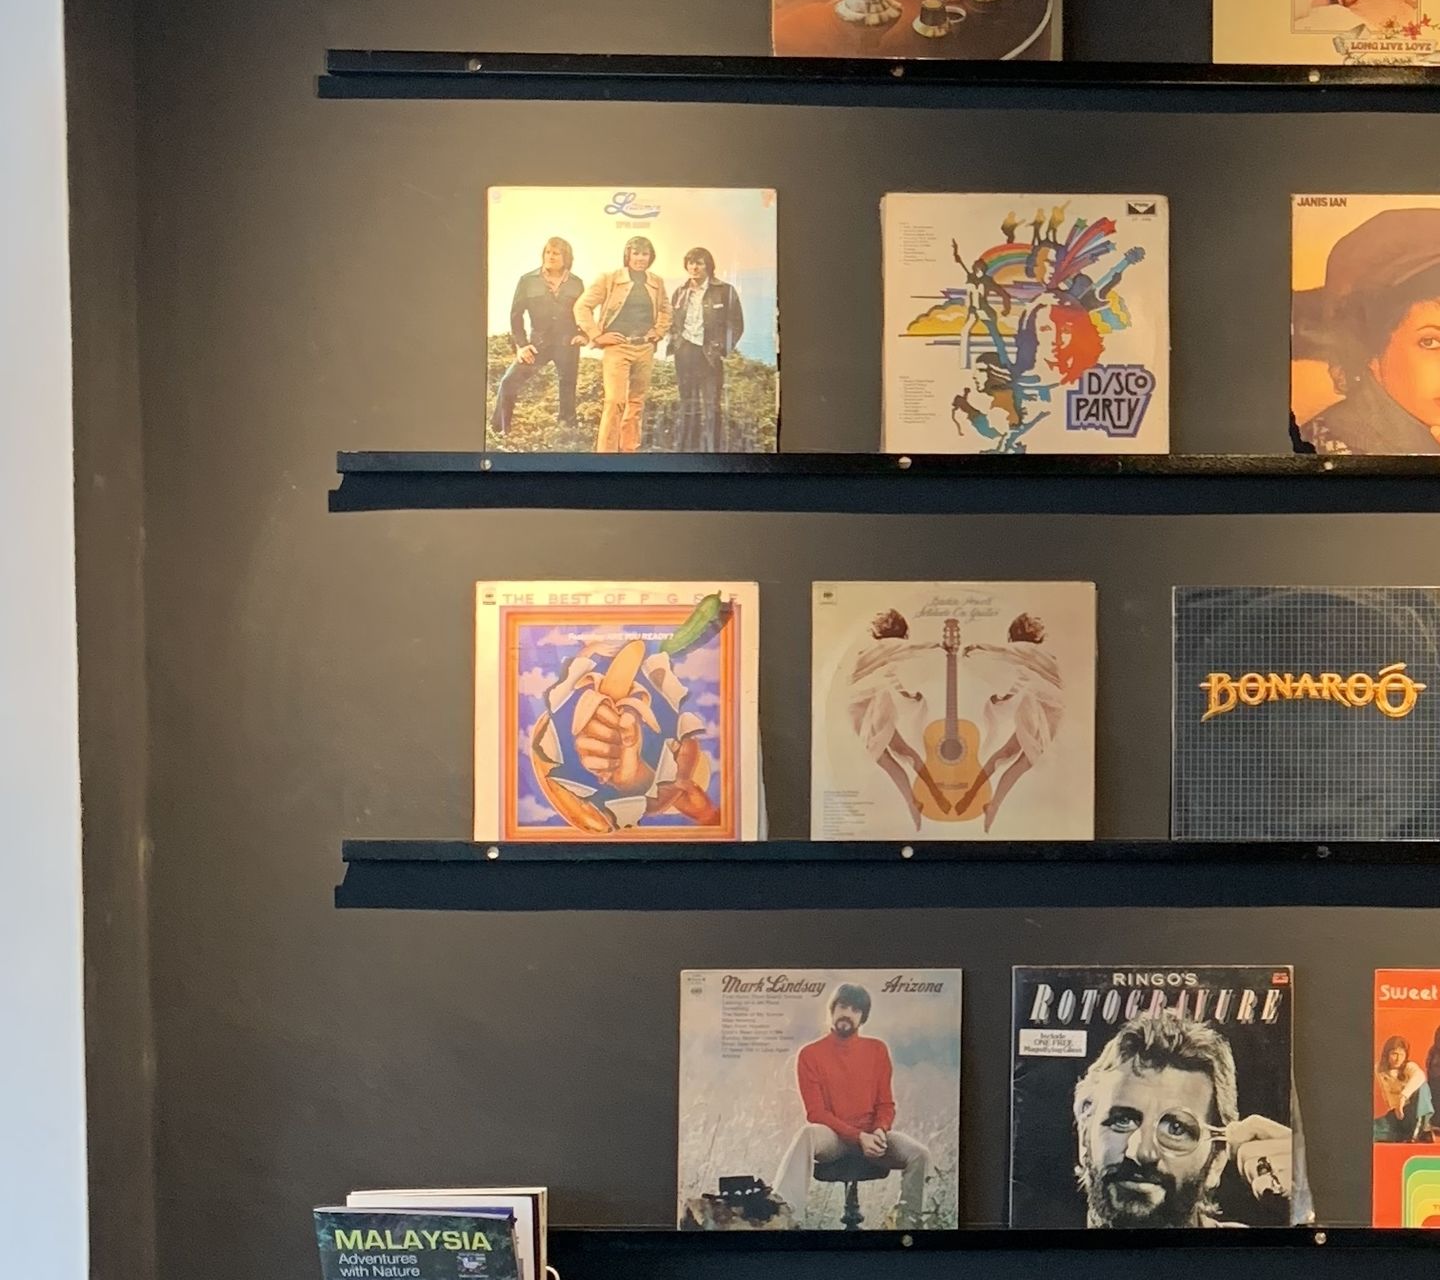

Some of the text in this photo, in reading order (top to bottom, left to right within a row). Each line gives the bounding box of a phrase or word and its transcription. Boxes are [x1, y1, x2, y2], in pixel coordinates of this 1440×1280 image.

[1351, 42, 1431, 51] LONG LIVE LOVE
[1297, 197, 1346, 207] JANIS IAN
[1075, 397, 1140, 429] PARTY
[504, 594, 534, 604] THE
[550, 594, 592, 604] BEST
[604, 594, 626, 604] OF
[640, 594, 648, 604] P
[667, 594, 678, 604] G
[722, 974, 826, 997] Mark Lindsay
[881, 975, 944, 993] Arizona
[1112, 972, 1199, 987] RINGO'S
[1380, 985, 1438, 1000] Sweet
[1030, 983, 1283, 1025] ROTOGRAVURE
[334, 1230, 492, 1251] MALAYSIA
[338, 1254, 417, 1265] Adventures
[340, 1267, 420, 1277] with Nature
